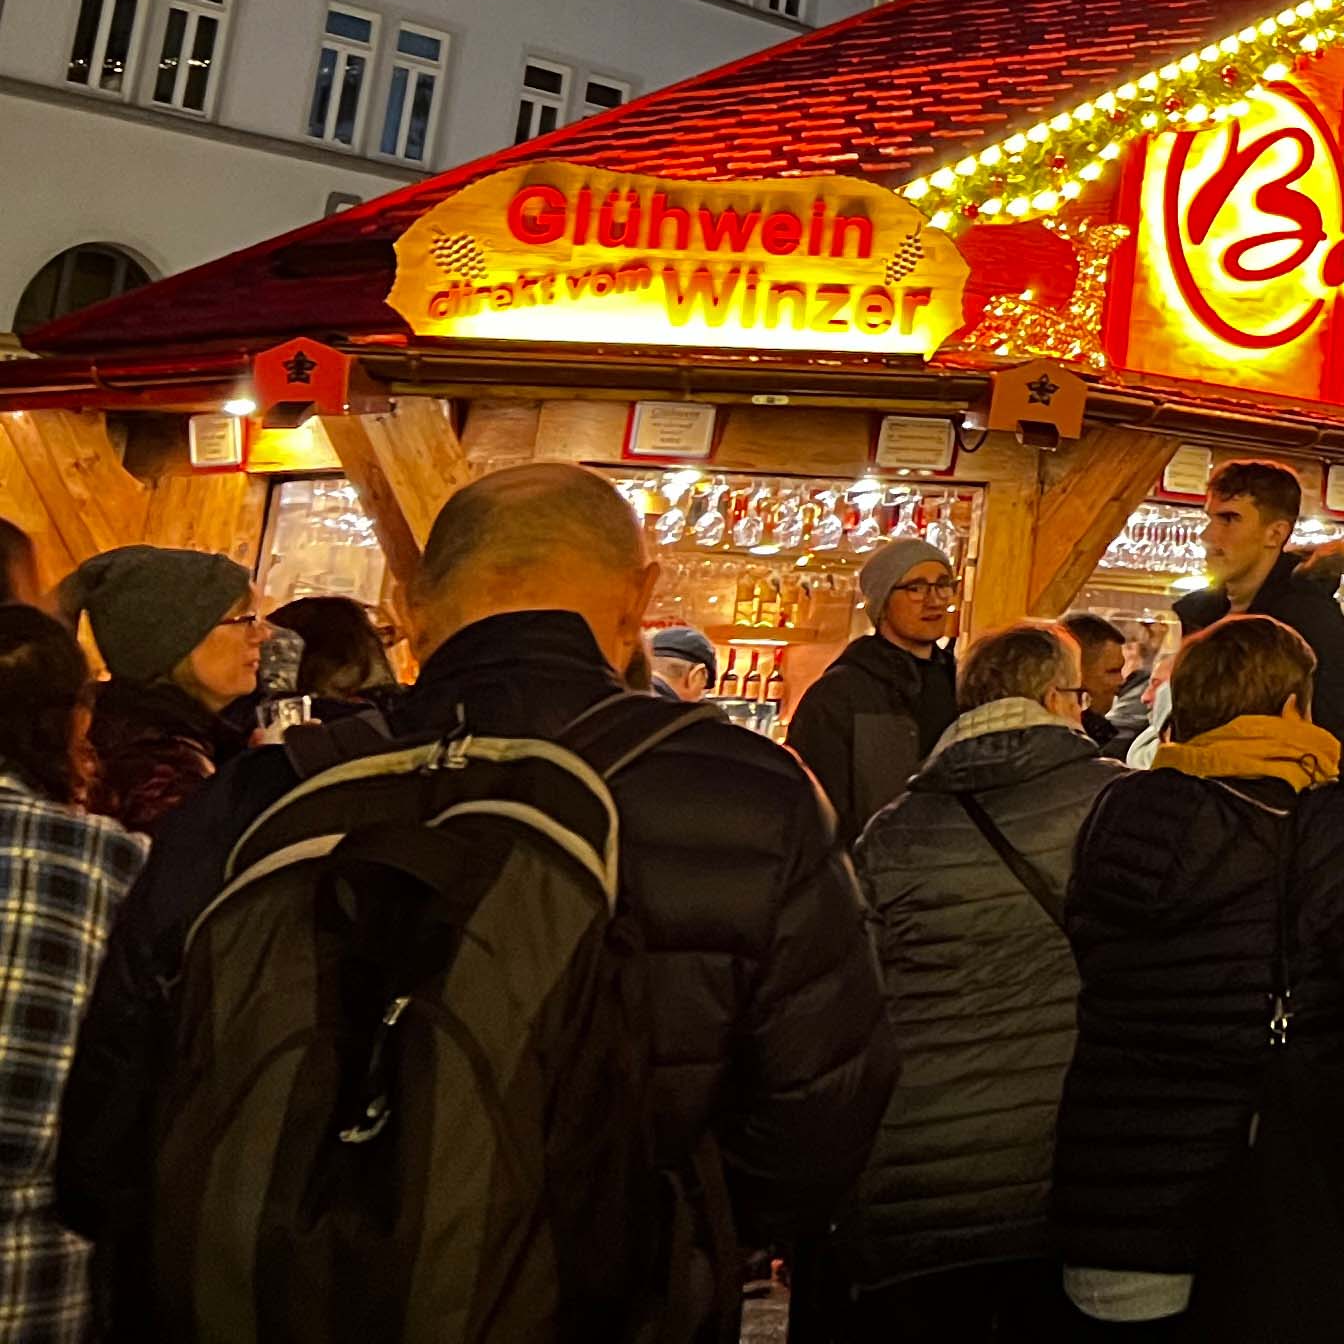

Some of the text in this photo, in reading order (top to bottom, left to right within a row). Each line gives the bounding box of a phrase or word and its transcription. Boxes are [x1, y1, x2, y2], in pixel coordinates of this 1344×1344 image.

[508, 183, 874, 258] Glühwein
[428, 261, 933, 336] direkt vom Winzer
